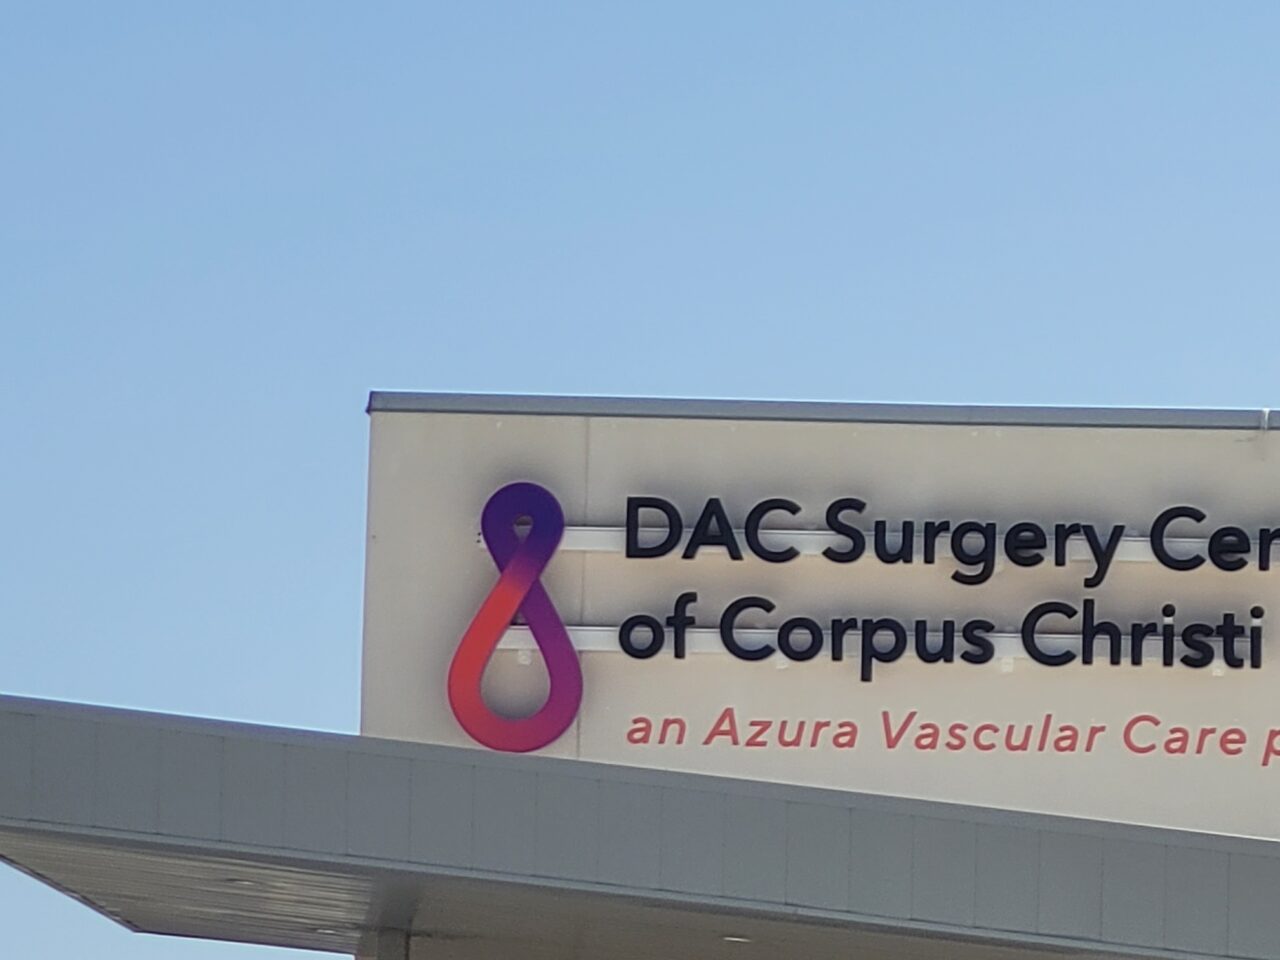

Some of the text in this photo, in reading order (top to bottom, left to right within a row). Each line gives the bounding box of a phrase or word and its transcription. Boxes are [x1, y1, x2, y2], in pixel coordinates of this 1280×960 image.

[625, 496, 802, 564] DAC
[822, 497, 1127, 588] Surgery
[617, 591, 1265, 683] of Corpus Christi
[626, 715, 688, 746] an
[703, 707, 860, 750] Azura
[881, 710, 1107, 754] Vascular
[1122, 714, 1248, 757] Care
